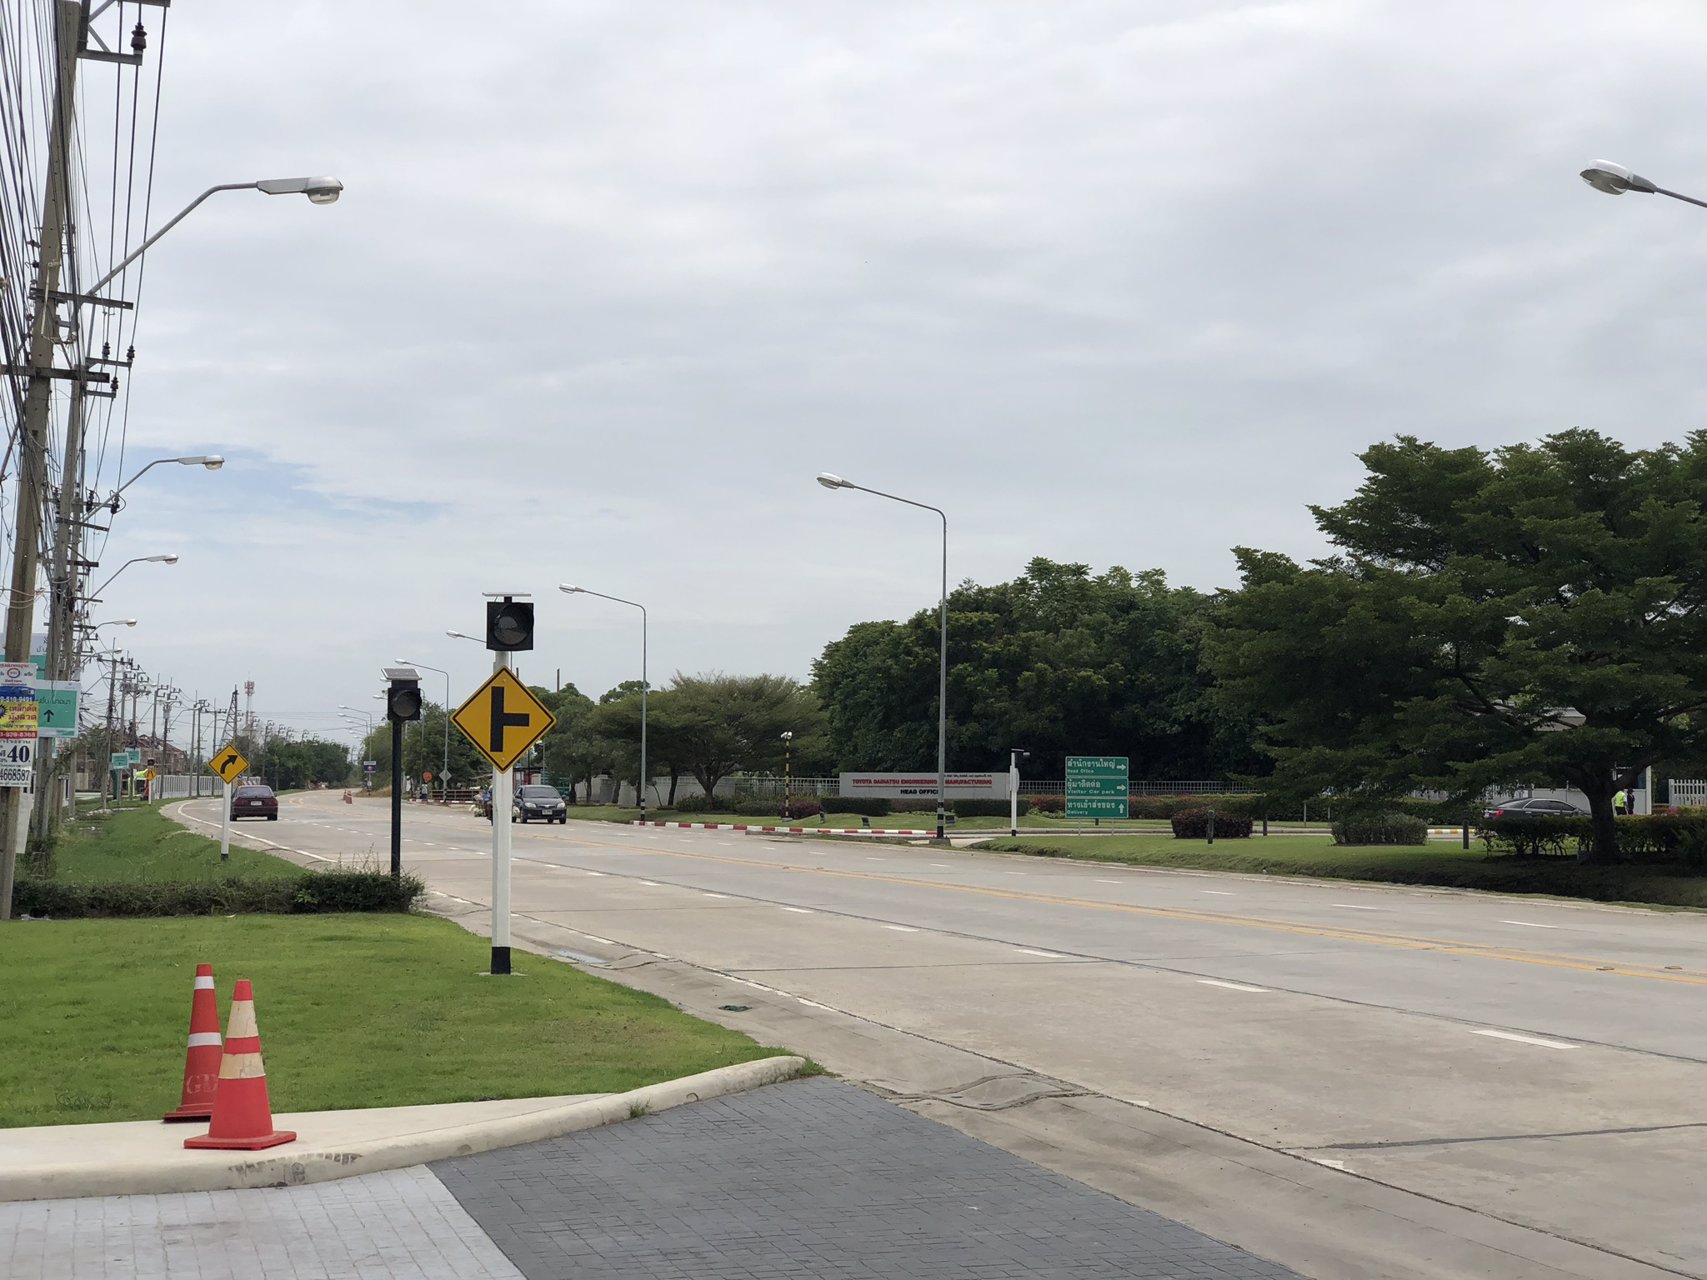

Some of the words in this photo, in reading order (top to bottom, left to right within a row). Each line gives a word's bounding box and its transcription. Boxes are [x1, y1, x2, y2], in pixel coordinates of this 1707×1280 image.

[1067, 759, 1116, 769] สำนักงานใหญ่
[1067, 779, 1101, 790] ผู้มาติดต่อ
